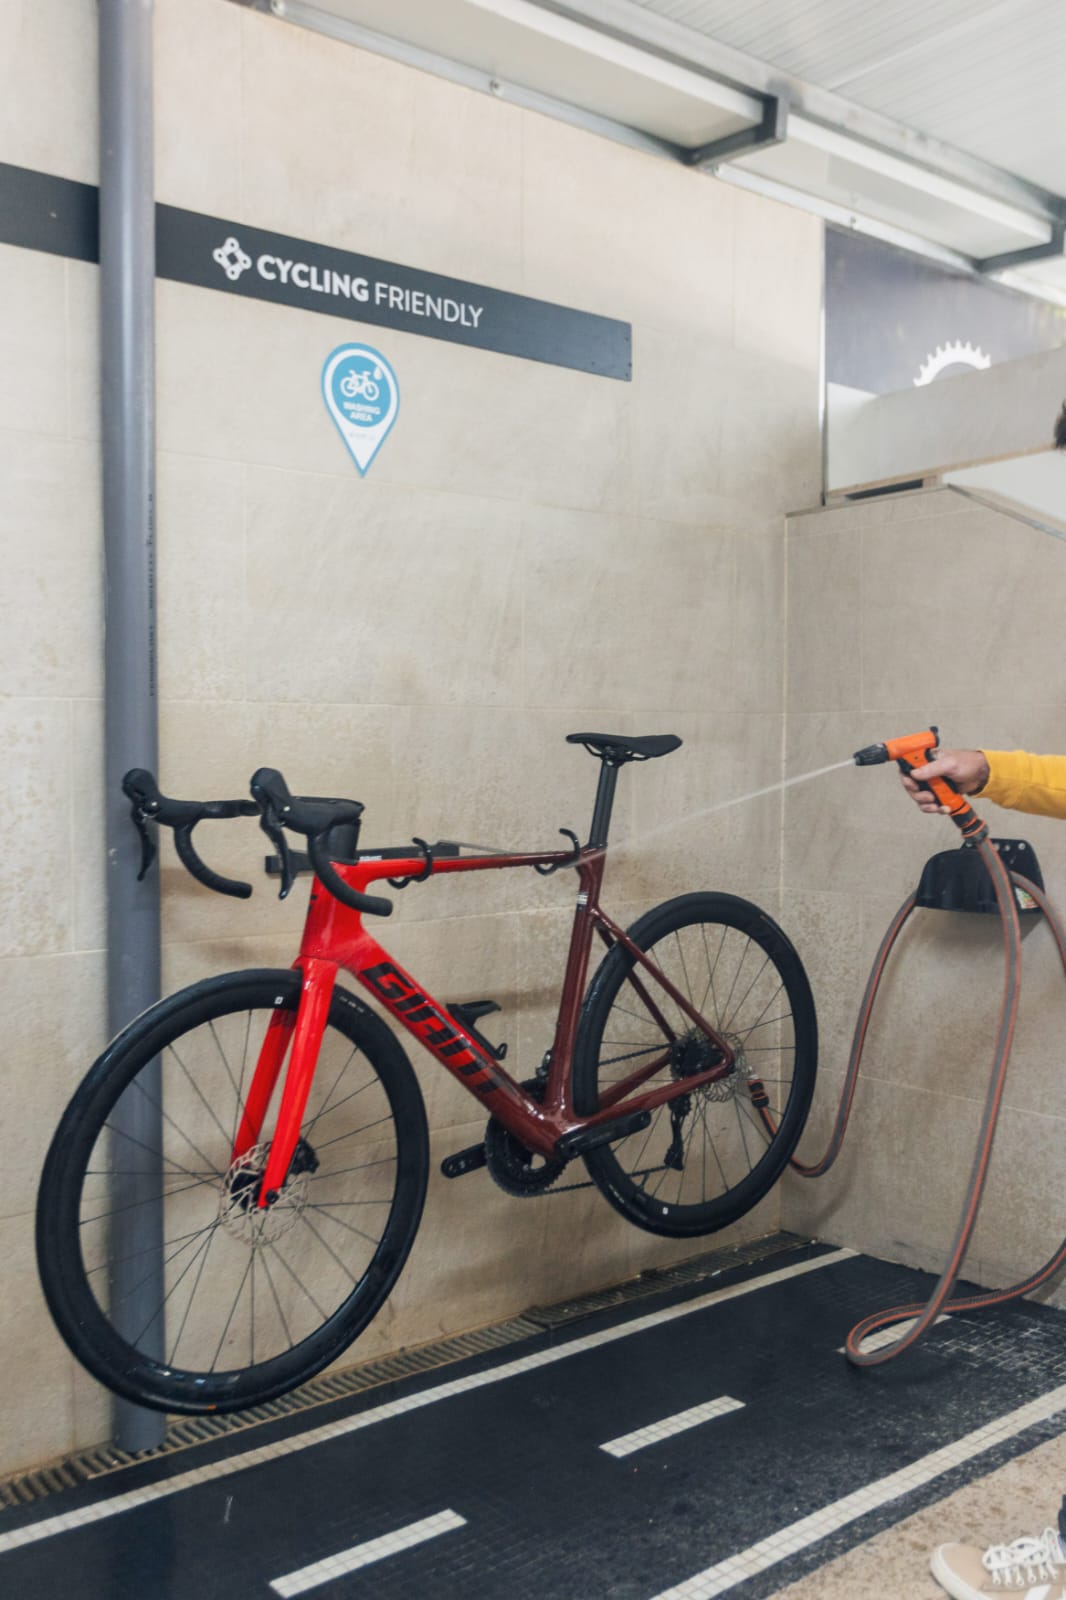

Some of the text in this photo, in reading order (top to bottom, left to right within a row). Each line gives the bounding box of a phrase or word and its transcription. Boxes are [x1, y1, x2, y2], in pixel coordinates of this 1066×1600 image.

[257, 254, 484, 328] CYCLING FRIENDLY
[350, 411, 373, 422] AREA
[361, 961, 514, 1091] GIANT
